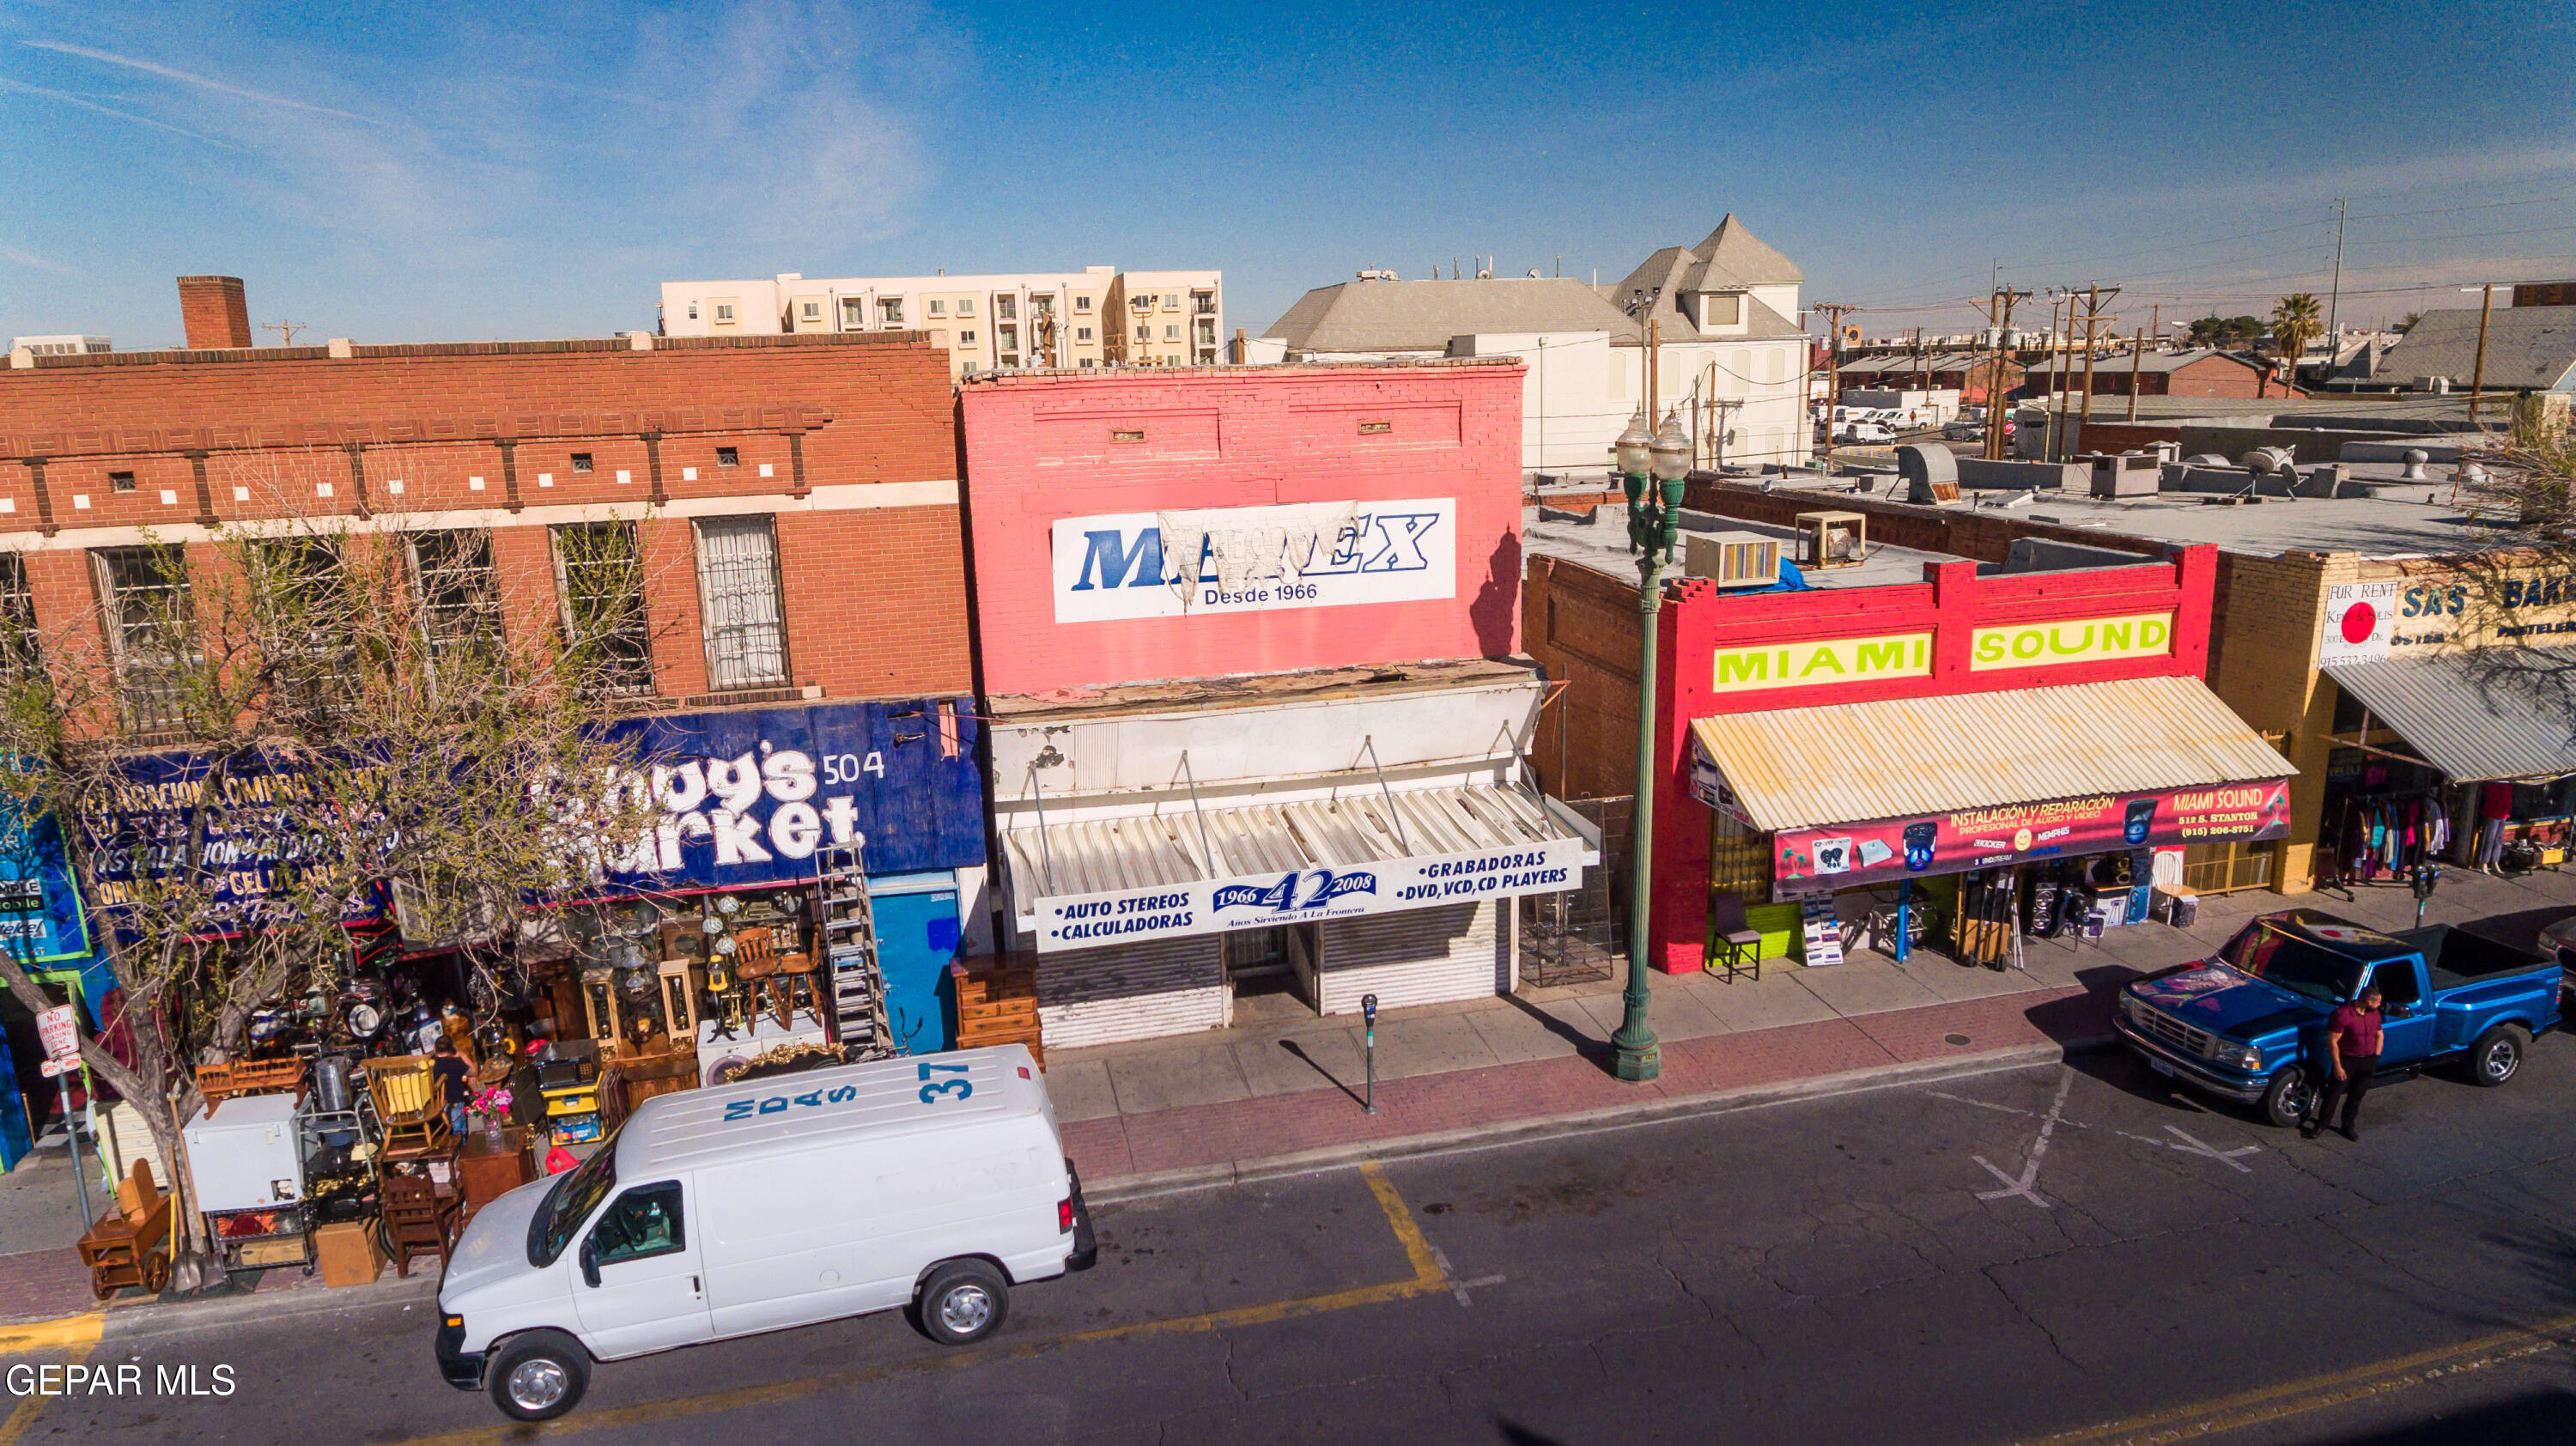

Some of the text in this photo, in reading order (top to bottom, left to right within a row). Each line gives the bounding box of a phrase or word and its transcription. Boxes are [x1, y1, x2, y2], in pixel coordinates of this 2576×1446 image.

[1205, 584, 1317, 605] Desde 1966
[2330, 583, 2397, 599] FOR RENT
[2403, 585, 2468, 617] SAS
[1718, 620, 2167, 684] MIAMI SOUND
[824, 750, 884, 785] 504
[1951, 795, 2116, 828] INSTALACIÓN Y REPARACIÓN
[2172, 788, 2263, 811] MIAMI SOUND
[1959, 819, 2020, 835] PROFESIONAL
[2021, 817, 2033, 827] DE
[2034, 815, 2065, 825] AUDIO
[2074, 811, 2101, 821] VIDEO
[2198, 815, 2208, 823] S.
[2210, 812, 2258, 823] STANTON
[2181, 827, 2208, 838] (915)
[1428, 851, 1546, 878] GRABADORAS
[1502, 867, 1568, 890] PLAYERS
[1217, 868, 1372, 914] 1966 42 2008
[1064, 892, 1190, 920] AUTO STEREOS
[1253, 913, 1297, 925] Sirviendo
[1310, 910, 1323, 919] La
[1326, 907, 1364, 917] Frontera
[1061, 911, 1194, 940] CALCULADORAS
[41, 1019, 72, 1036] PARKING
[46, 1012, 61, 1024] NO
[918, 1061, 974, 1105] 37
